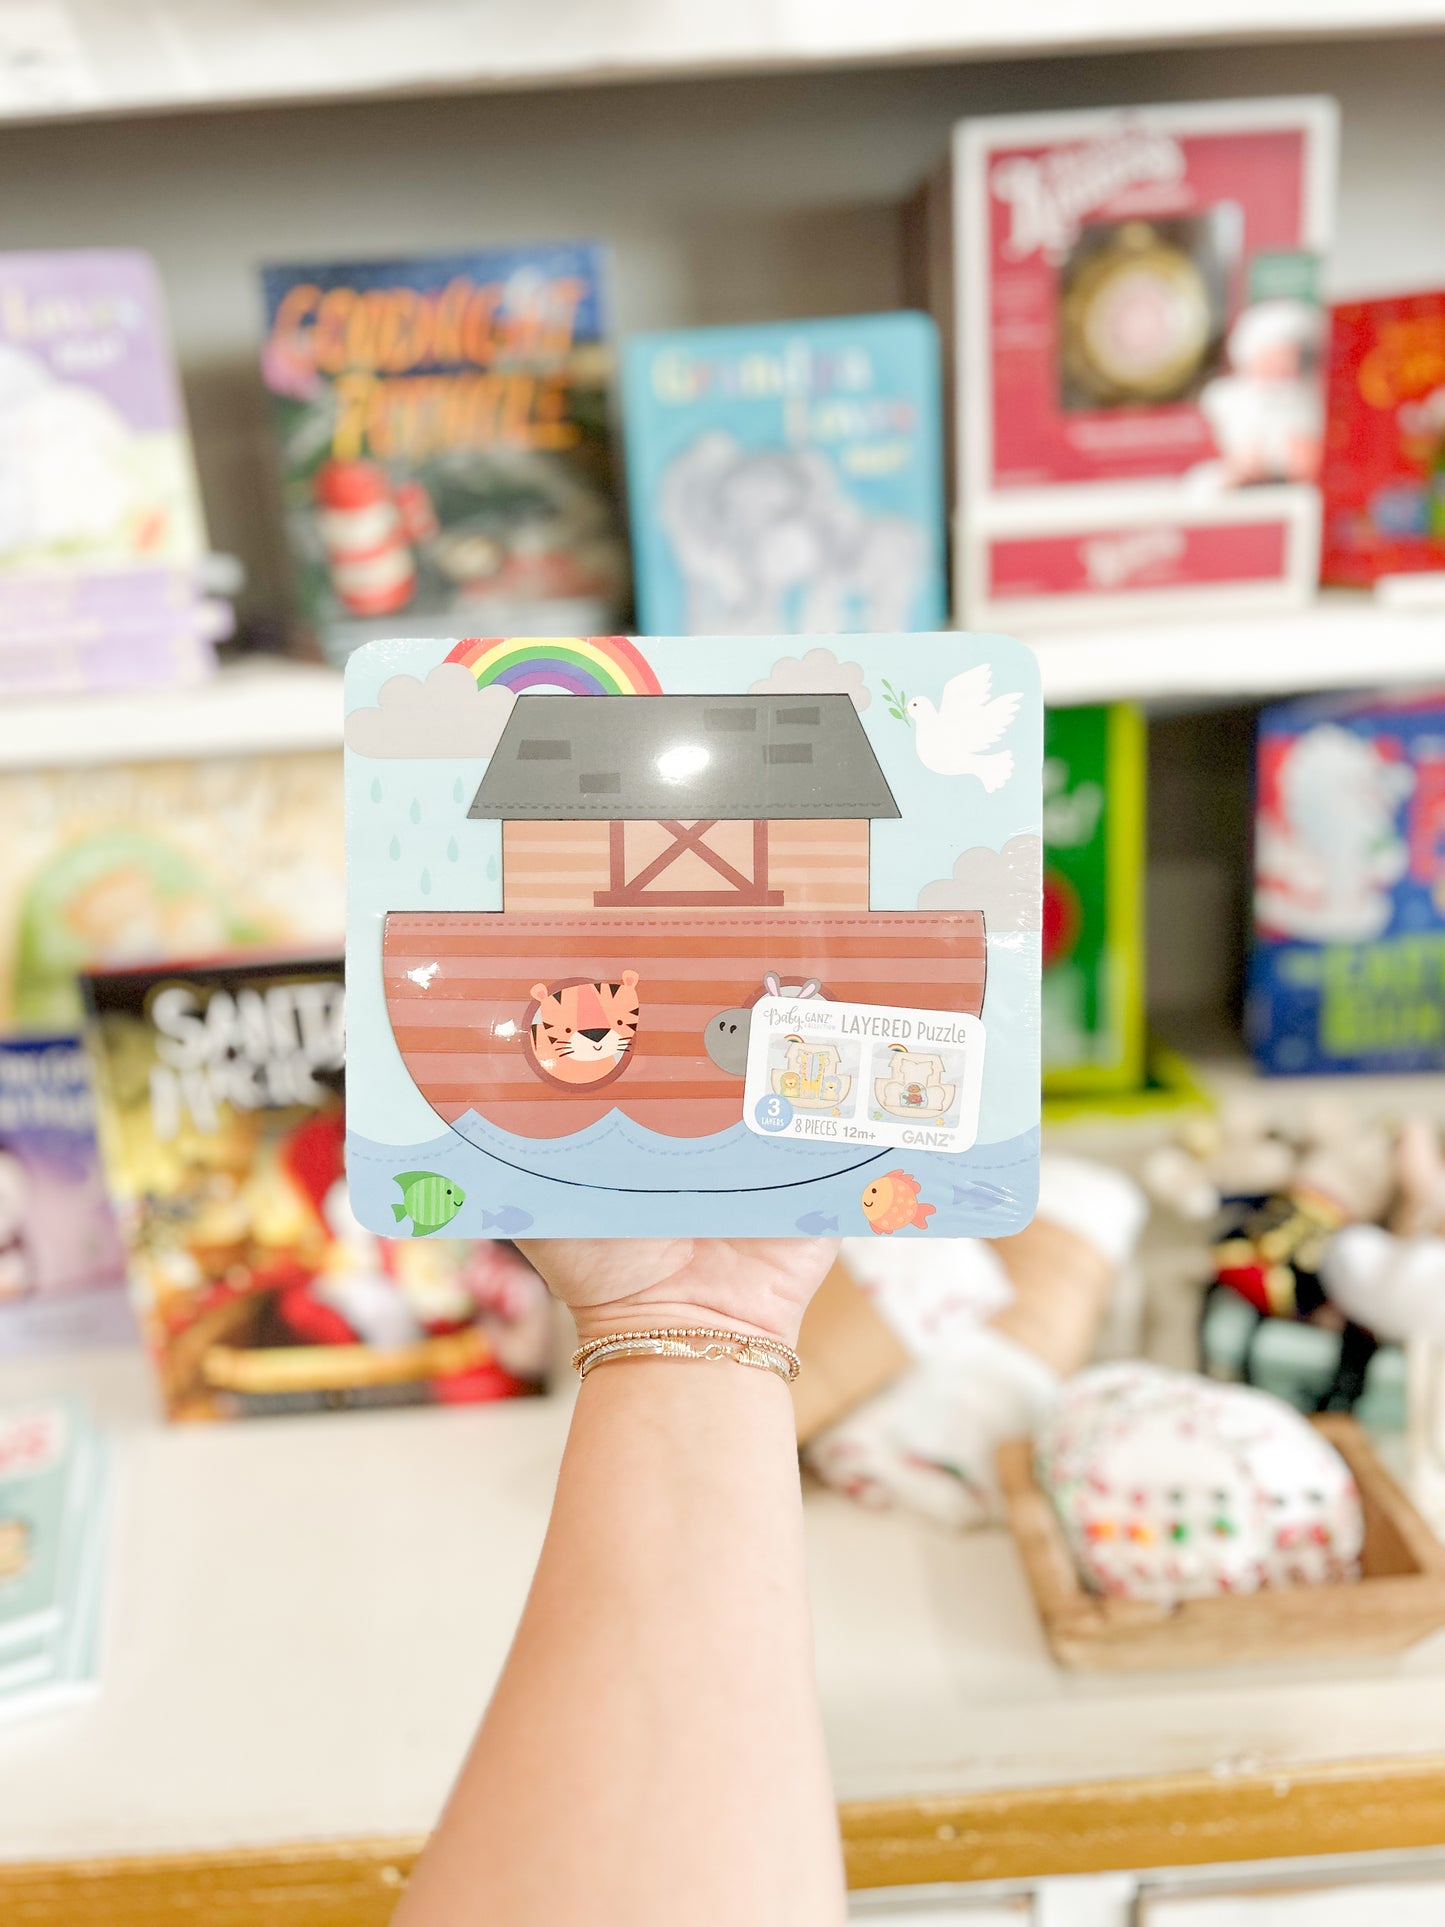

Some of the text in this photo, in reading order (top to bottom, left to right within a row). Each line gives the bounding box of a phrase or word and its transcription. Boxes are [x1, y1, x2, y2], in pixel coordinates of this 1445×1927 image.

[763, 1005, 804, 1032] Baby
[841, 1014, 966, 1044] LAYERED Puzzle
[767, 1098, 781, 1117] 3
[761, 1117, 785, 1127] LAYERS
[795, 1118, 837, 1137] 8 PIECES
[843, 1126, 876, 1141] 12m+
